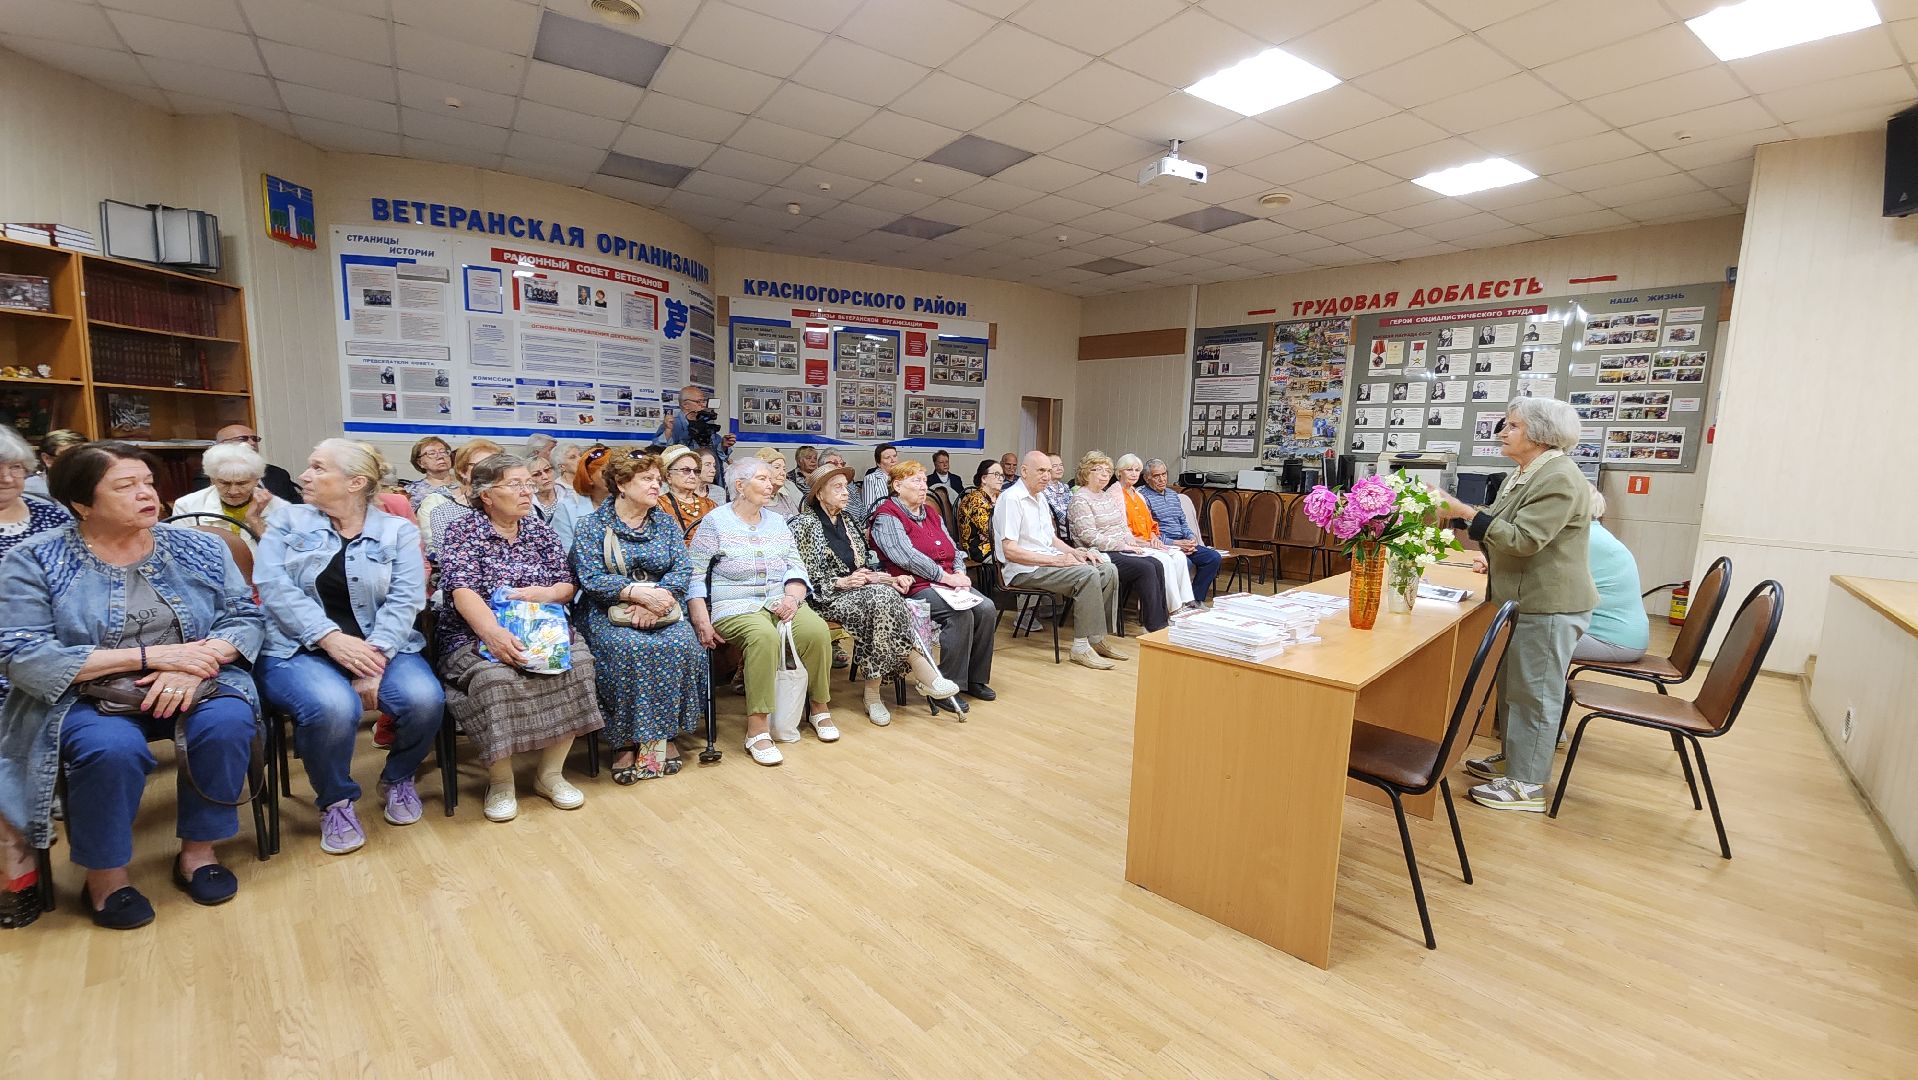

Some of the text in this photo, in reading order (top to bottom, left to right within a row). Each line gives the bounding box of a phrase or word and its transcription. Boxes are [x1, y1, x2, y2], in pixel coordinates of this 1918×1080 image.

[346, 234, 400, 245] СТРАНИЦЫ
[371, 197, 710, 286] ВЕТЕРАНСКАЯ ОРГАНИЗАЦИЯ
[389, 247, 435, 257] ИСТОРИИ
[503, 252, 663, 289] РАЙОННЫЙ СОВЕТ ВЕТЕРАНОВ
[743, 279, 906, 311] КРАСНОГОРСКОГО
[914, 295, 967, 317] РАЙОН
[1293, 277, 1544, 317] ТРУДОВАЯ ДОБЛЕСТЬ
[1609, 293, 1686, 305] НАША ЖИЗНЬ
[882, 318, 923, 328] ОРГАНИЗАЦИИ
[1389, 308, 1534, 326] ГЕРОИ СОЦИАЛИСТИЧЕСКОГО ТРУДА
[473, 375, 512, 383] КОМИССИИ
